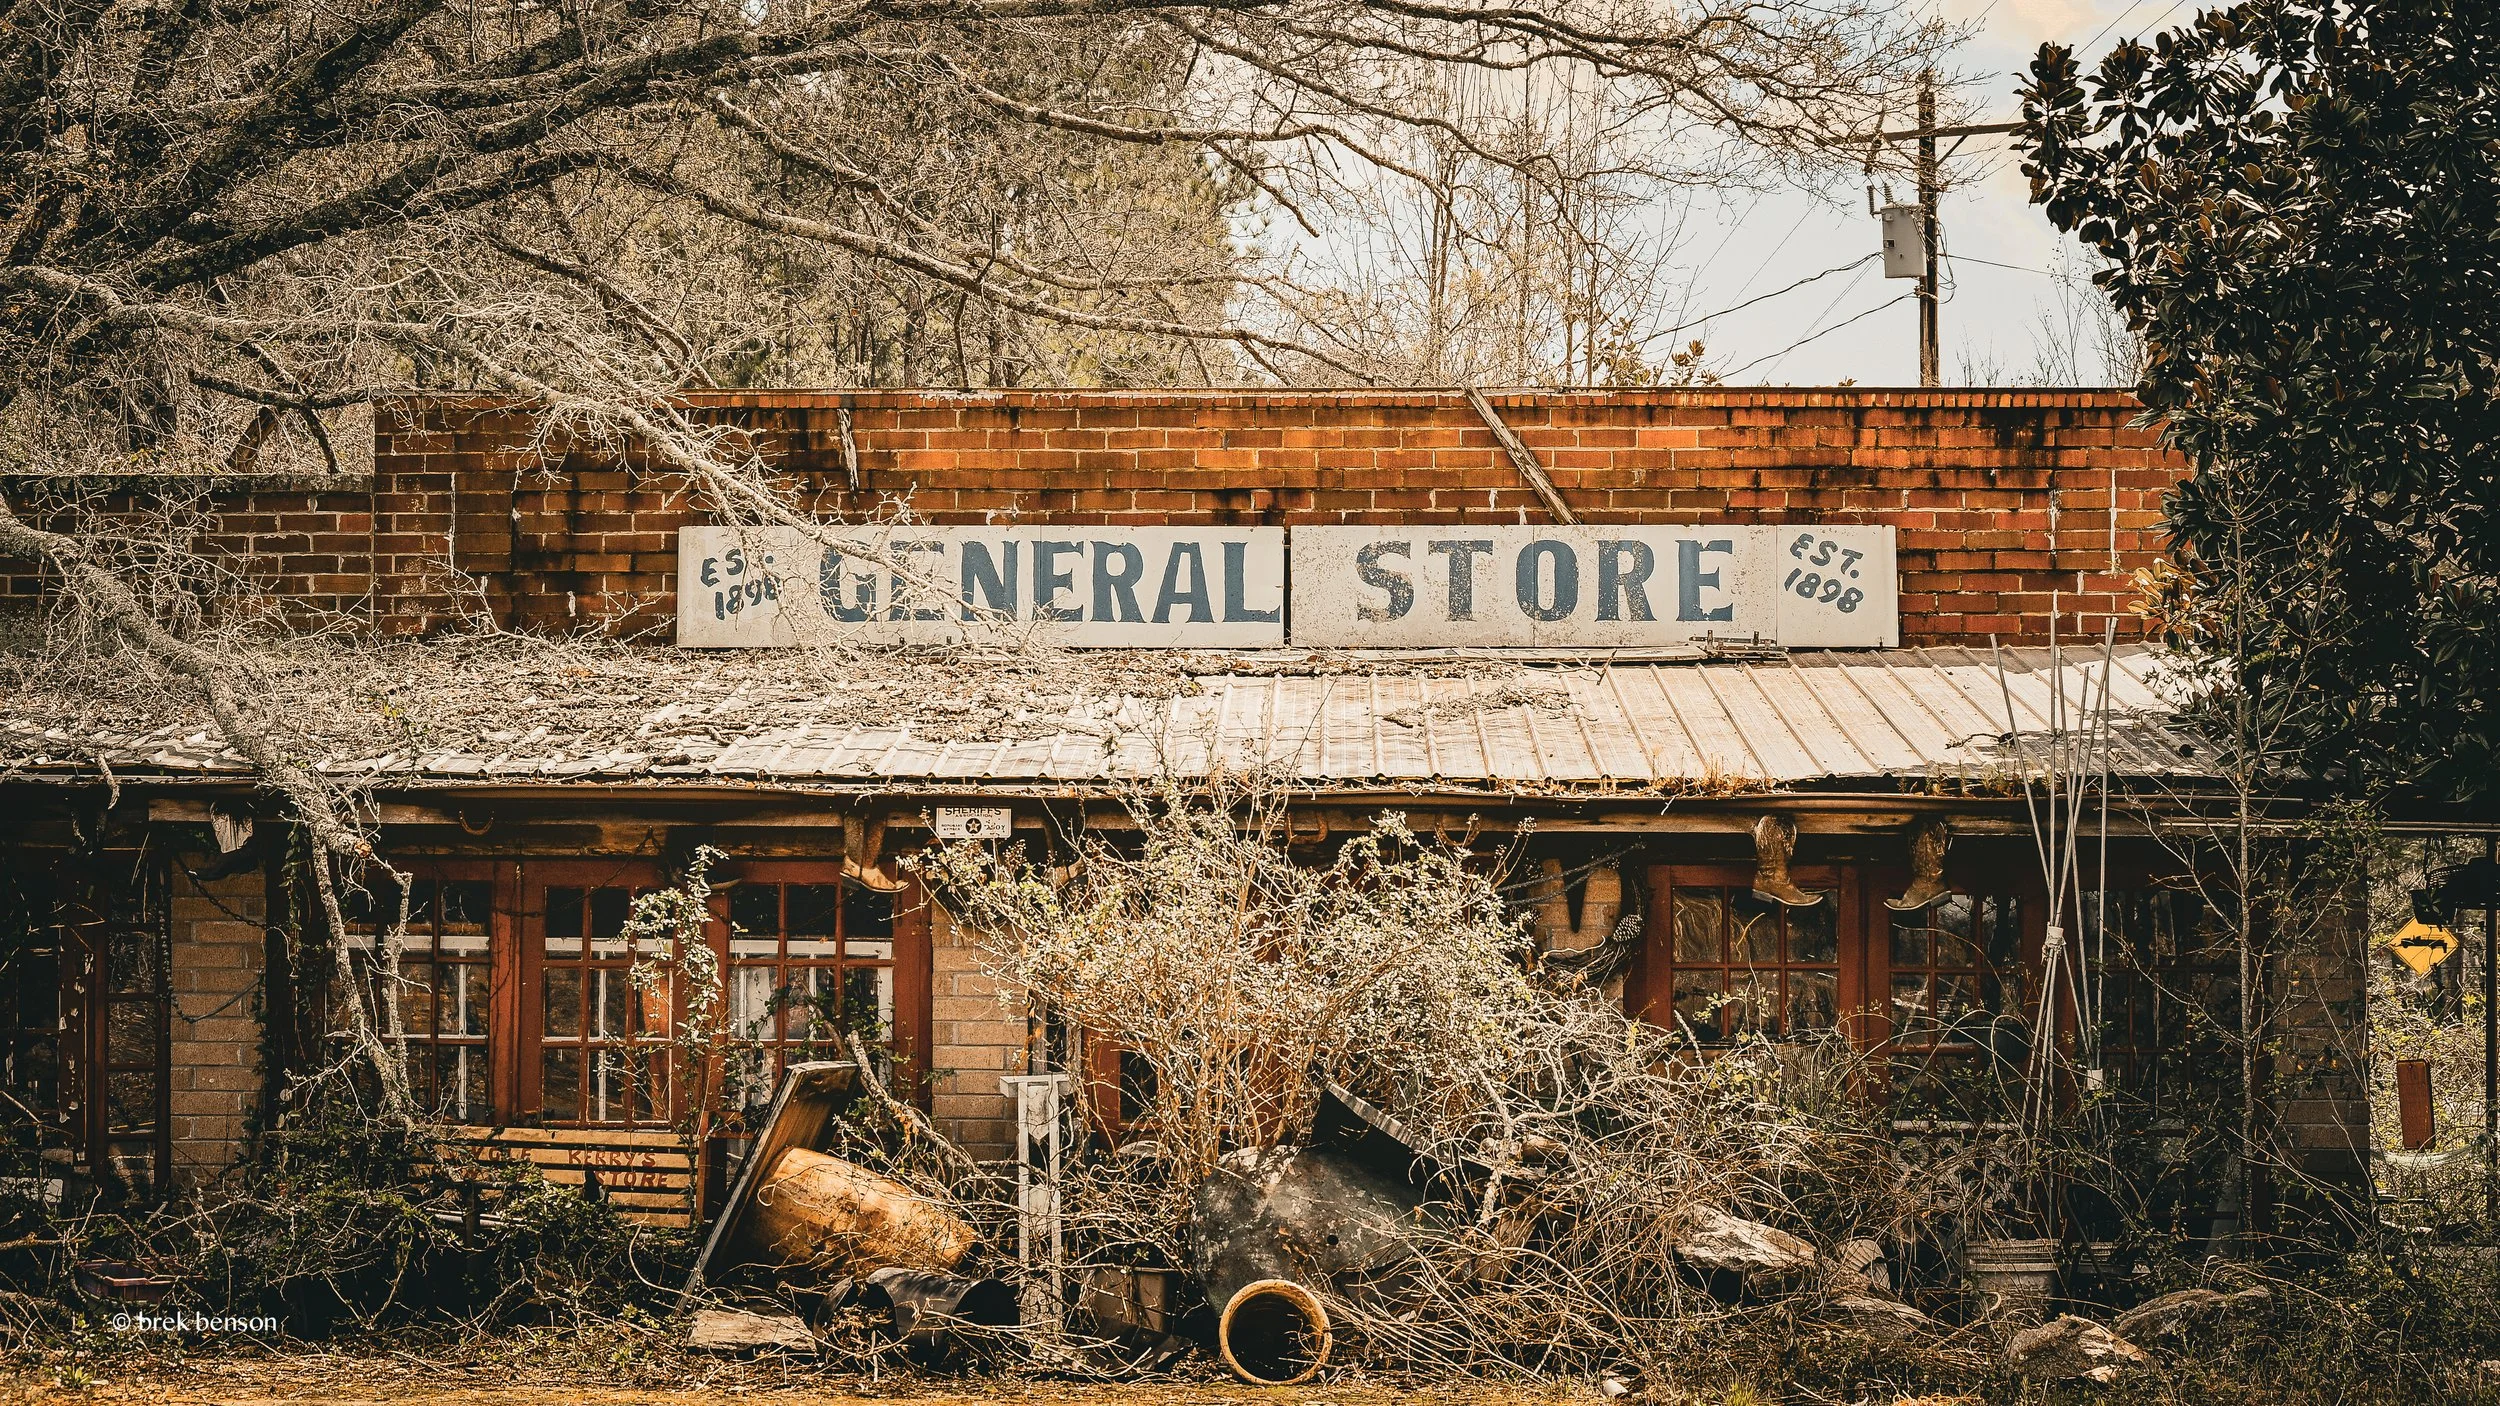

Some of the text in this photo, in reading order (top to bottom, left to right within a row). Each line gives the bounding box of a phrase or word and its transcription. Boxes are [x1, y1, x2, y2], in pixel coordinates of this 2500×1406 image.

[700, 549, 774, 588] ES.
[1789, 532, 1864, 579] EST.
[714, 573, 782, 621] 1898
[820, 539, 1734, 624] GENERAL STORE
[1784, 566, 1865, 614] 1898
[567, 1149, 656, 1168] KERRY'S
[594, 1171, 669, 1188] STORE
